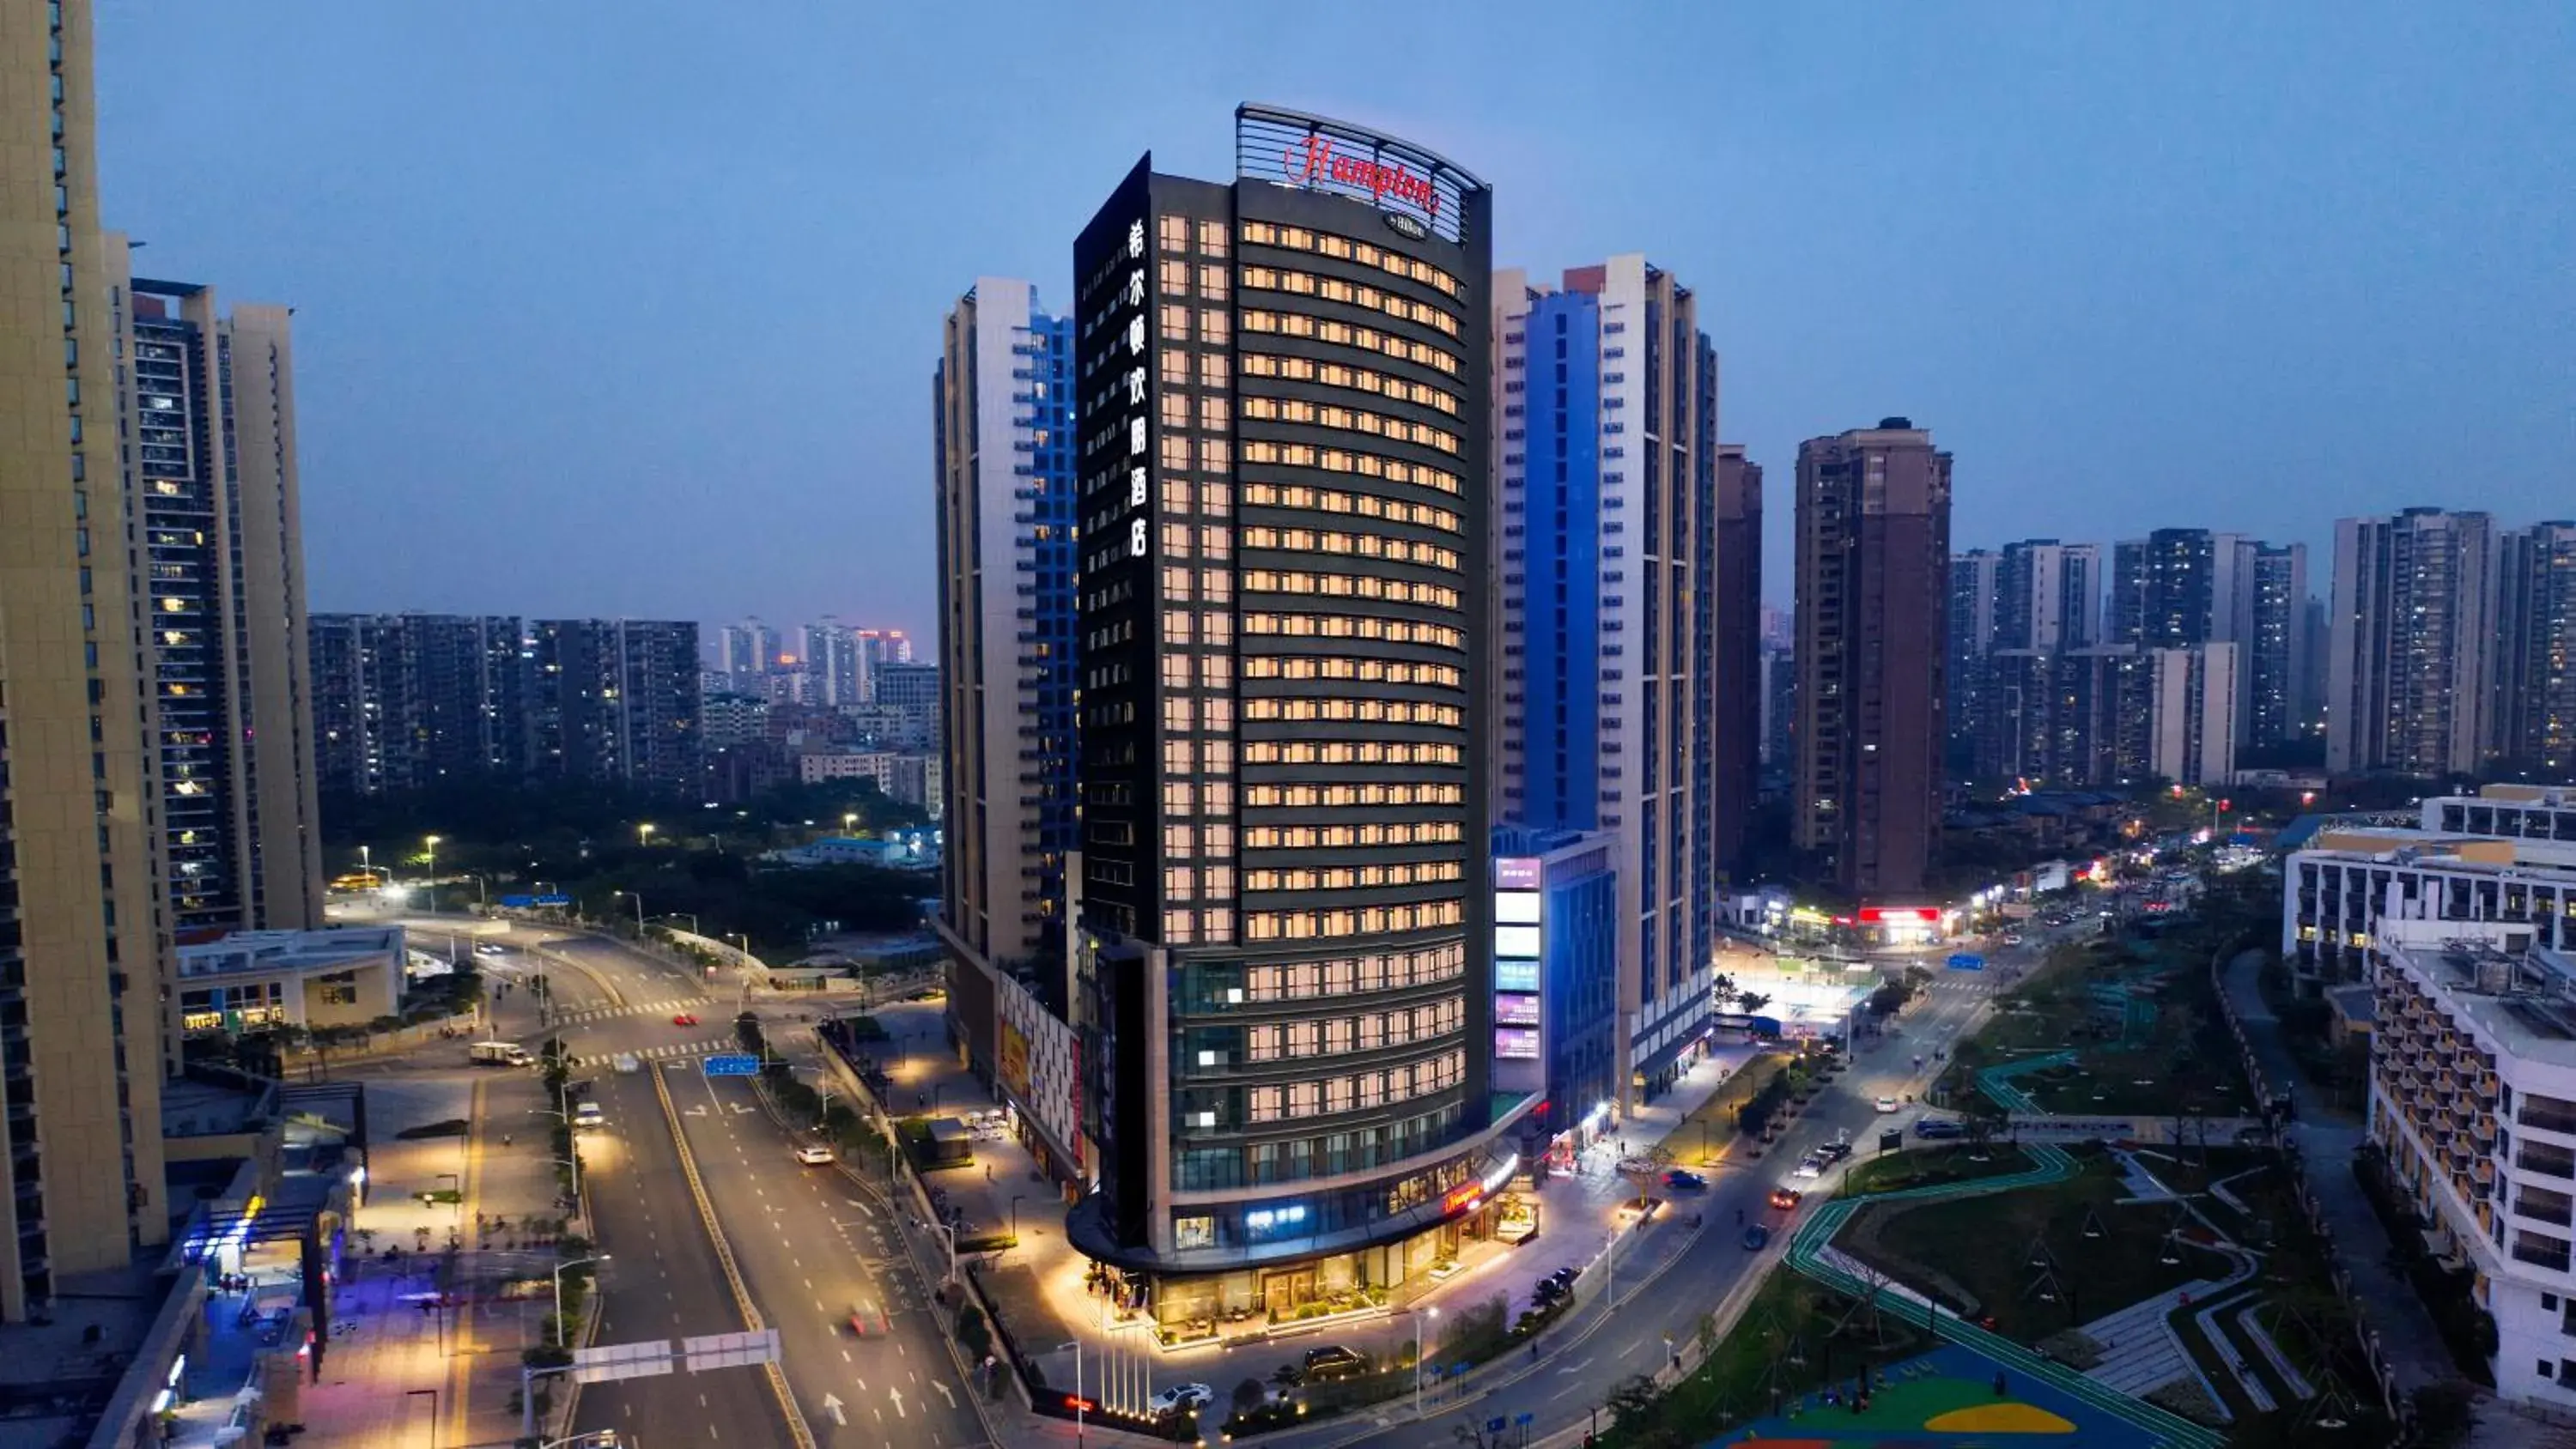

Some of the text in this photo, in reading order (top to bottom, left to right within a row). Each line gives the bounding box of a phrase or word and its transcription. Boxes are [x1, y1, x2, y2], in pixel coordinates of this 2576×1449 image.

[1285, 136, 1441, 215] Hampton
[1128, 219, 1146, 556] 希尔顿欢朋酒店
